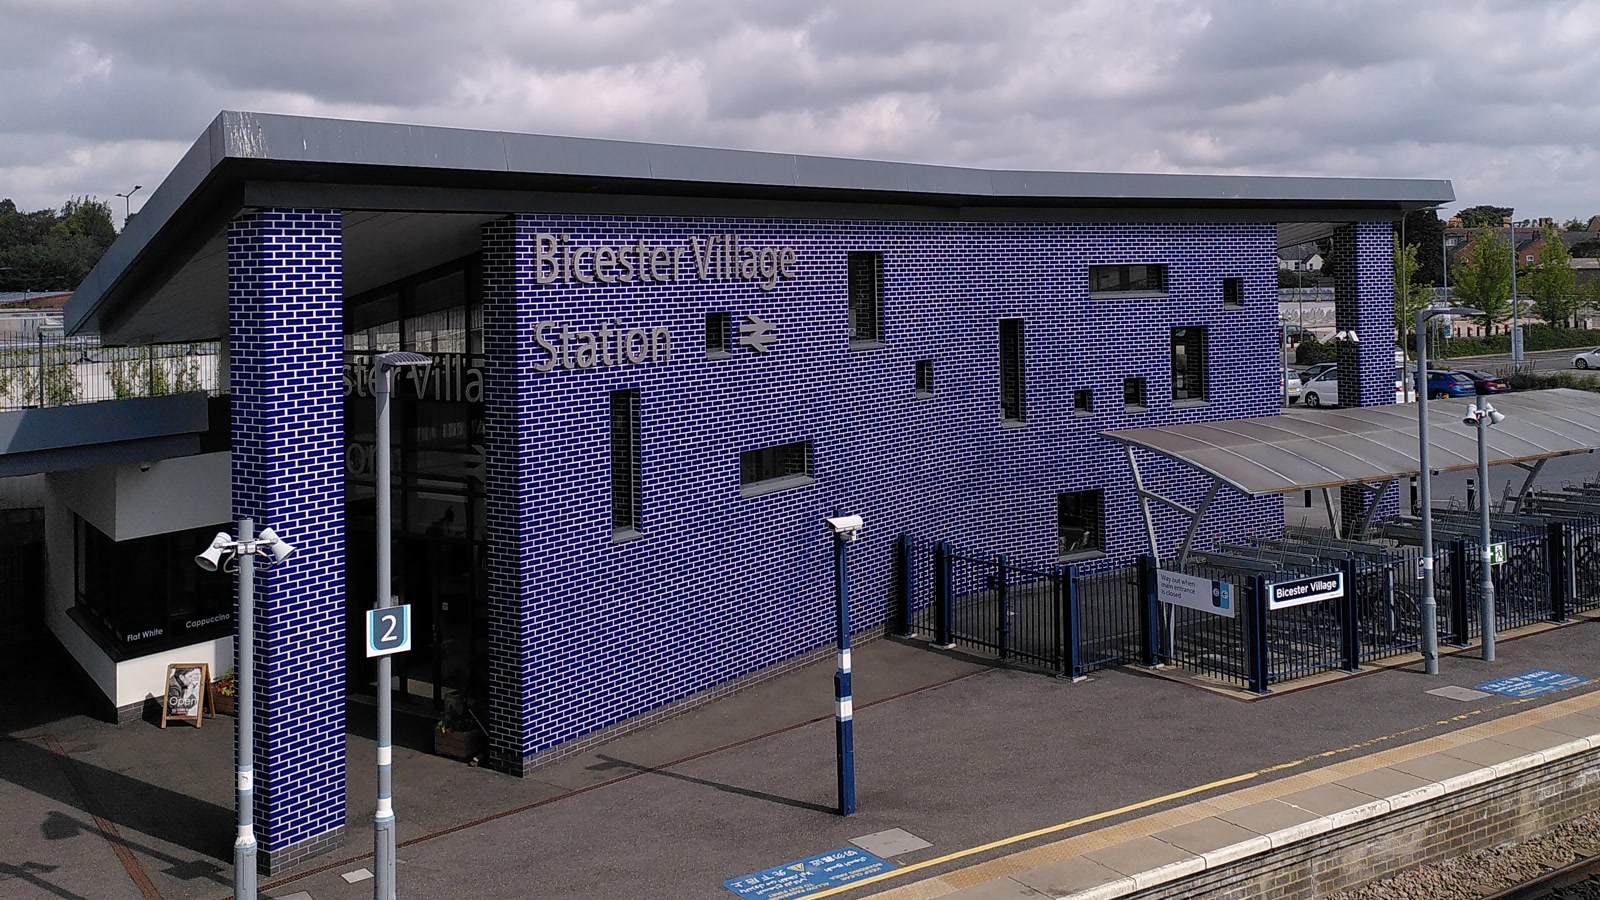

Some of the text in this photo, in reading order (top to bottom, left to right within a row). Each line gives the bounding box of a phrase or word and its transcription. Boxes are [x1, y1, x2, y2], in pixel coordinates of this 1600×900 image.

[534, 233, 796, 291] Bicester Village
[534, 317, 671, 372] Station
[1160, 574, 1195, 587] Way out when
[1166, 590, 1182, 599] closed
[1174, 585, 1195, 595] entrance
[1276, 580, 1337, 599] Bicester Village
[185, 613, 230, 629] Cappuccino
[380, 614, 398, 642] 2
[127, 628, 163, 642] Flat White
[169, 696, 197, 708] Open
